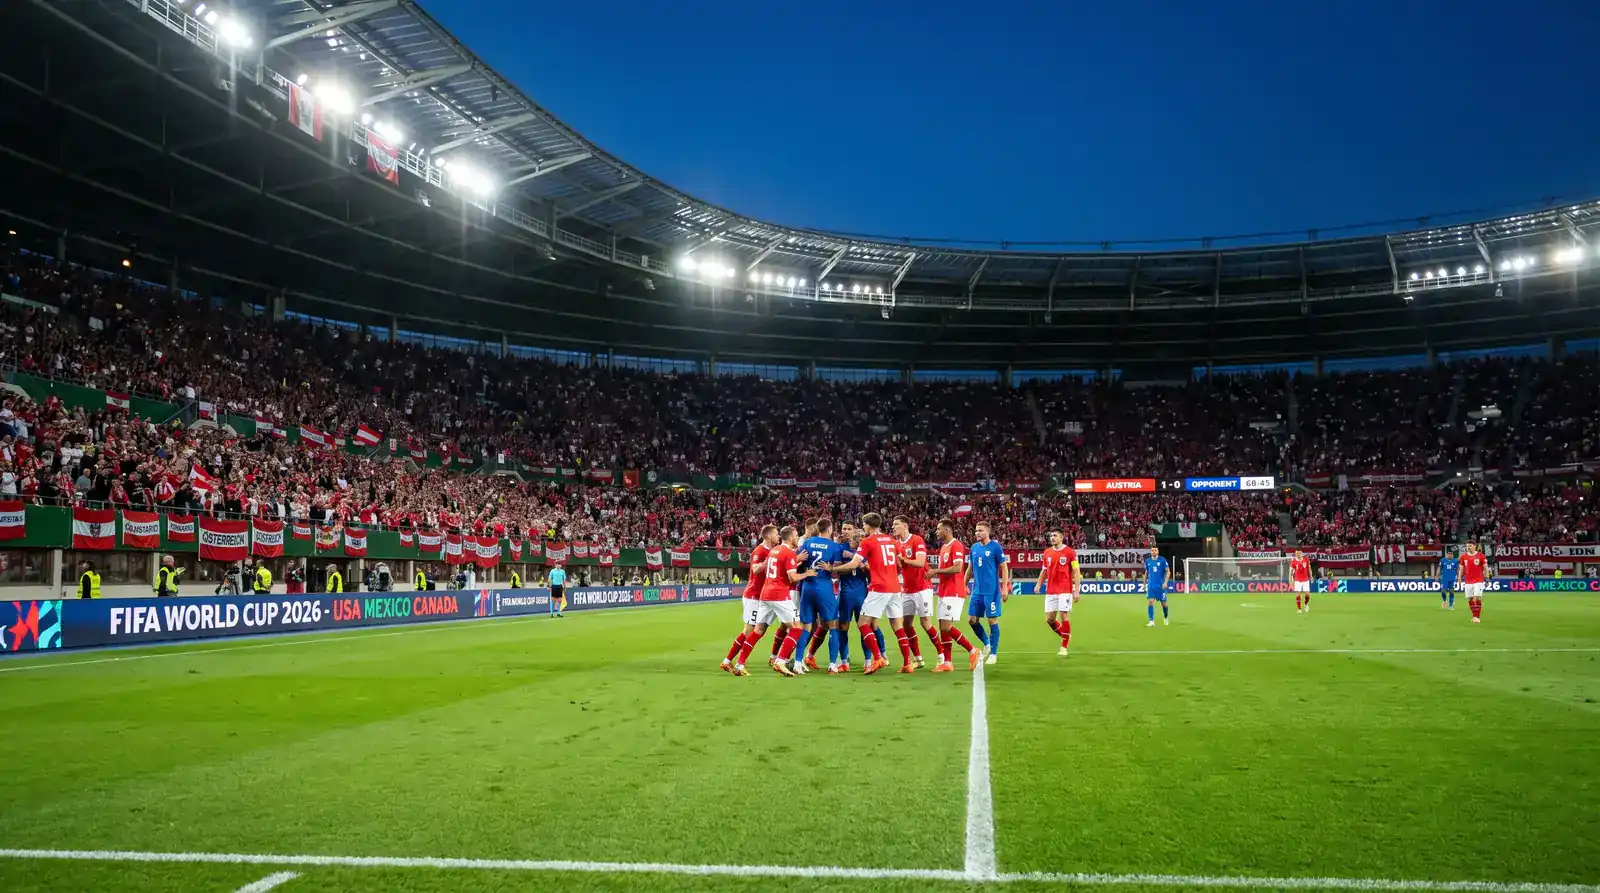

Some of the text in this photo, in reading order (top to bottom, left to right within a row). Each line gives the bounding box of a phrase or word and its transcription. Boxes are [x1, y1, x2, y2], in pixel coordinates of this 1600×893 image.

[1191, 480, 1237, 488] OPPONENT
[881, 544, 896, 566] 15
[766, 557, 778, 579] 15
[1079, 583, 1111, 593] ORLD
[1115, 583, 1135, 593] CUP
[1201, 582, 1245, 592] MEXICO
[1370, 581, 1396, 591] FIFA
[1397, 581, 1440, 591] WORLD
[1509, 581, 1536, 591] USA
[1539, 581, 1587, 591] MEXICO
[573, 592, 587, 605] FIFA
[587, 591, 607, 604] WORLD
[607, 590, 618, 603] CUP
[633, 589, 643, 602] USA
[643, 588, 659, 601] MEXICO
[990, 602, 997, 611] 6
[110, 606, 161, 635] FIFA
[164, 604, 240, 632] WORLD
[243, 601, 278, 627] CUP
[281, 600, 321, 624] 2026
[333, 599, 361, 620] USA
[364, 597, 411, 619] MEXICO
[413, 595, 458, 616] CANADA
